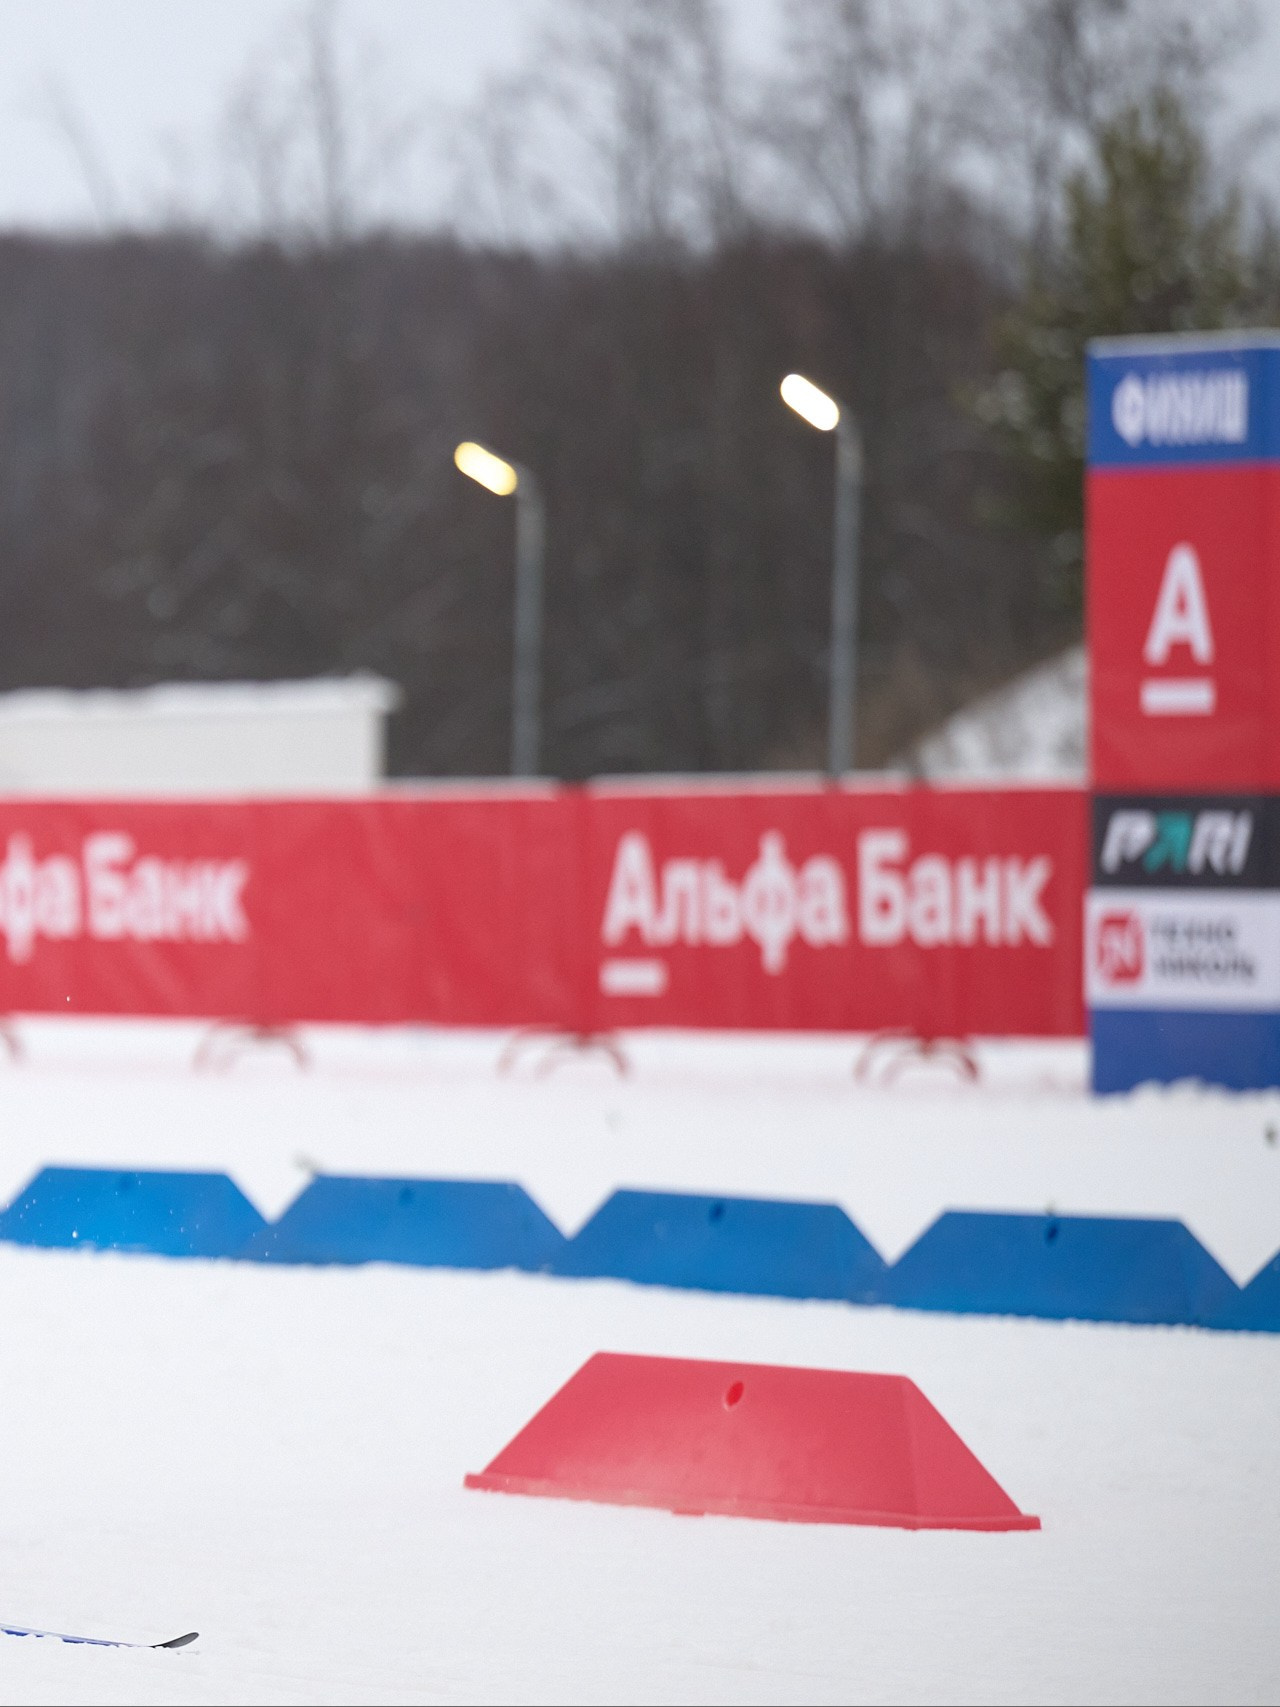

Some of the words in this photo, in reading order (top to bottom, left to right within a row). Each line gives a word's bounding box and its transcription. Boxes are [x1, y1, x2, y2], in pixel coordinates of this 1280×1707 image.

[1112, 370, 1249, 447] ФИНИШ
[84, 831, 251, 943] Банк
[1101, 809, 1254, 875] PARI
[602, 829, 848, 974] Альфа
[858, 829, 1054, 948] Банк
